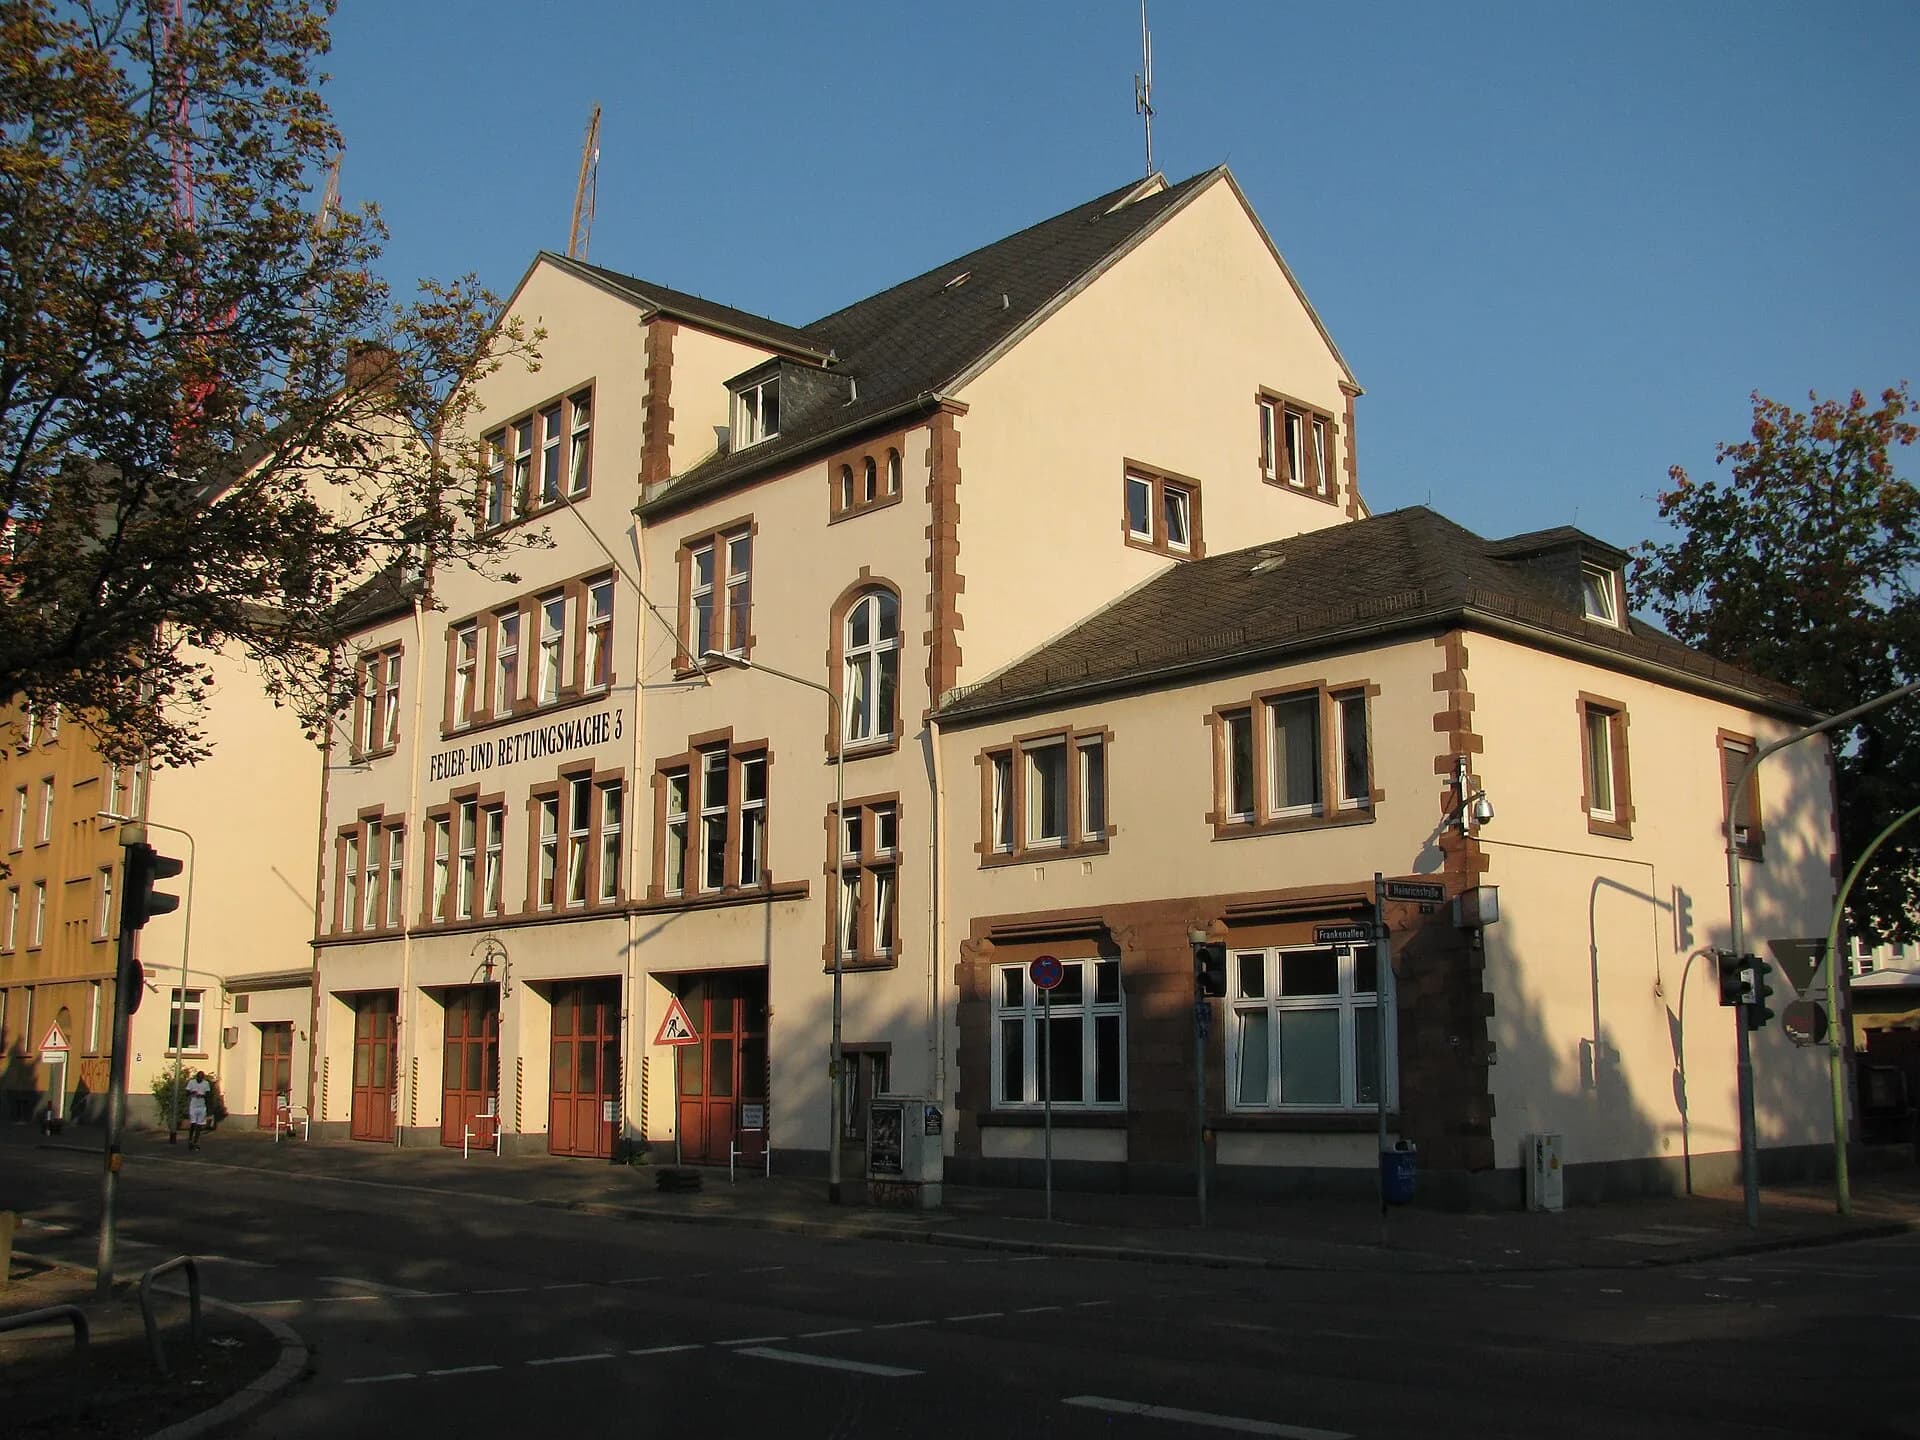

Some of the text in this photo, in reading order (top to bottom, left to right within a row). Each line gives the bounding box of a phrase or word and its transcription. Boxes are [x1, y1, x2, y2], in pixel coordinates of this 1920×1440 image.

[498, 712, 610, 767] RETTUNGSWACHE
[614, 708, 623, 740] 3
[1319, 928, 1364, 939] Frankenallee
